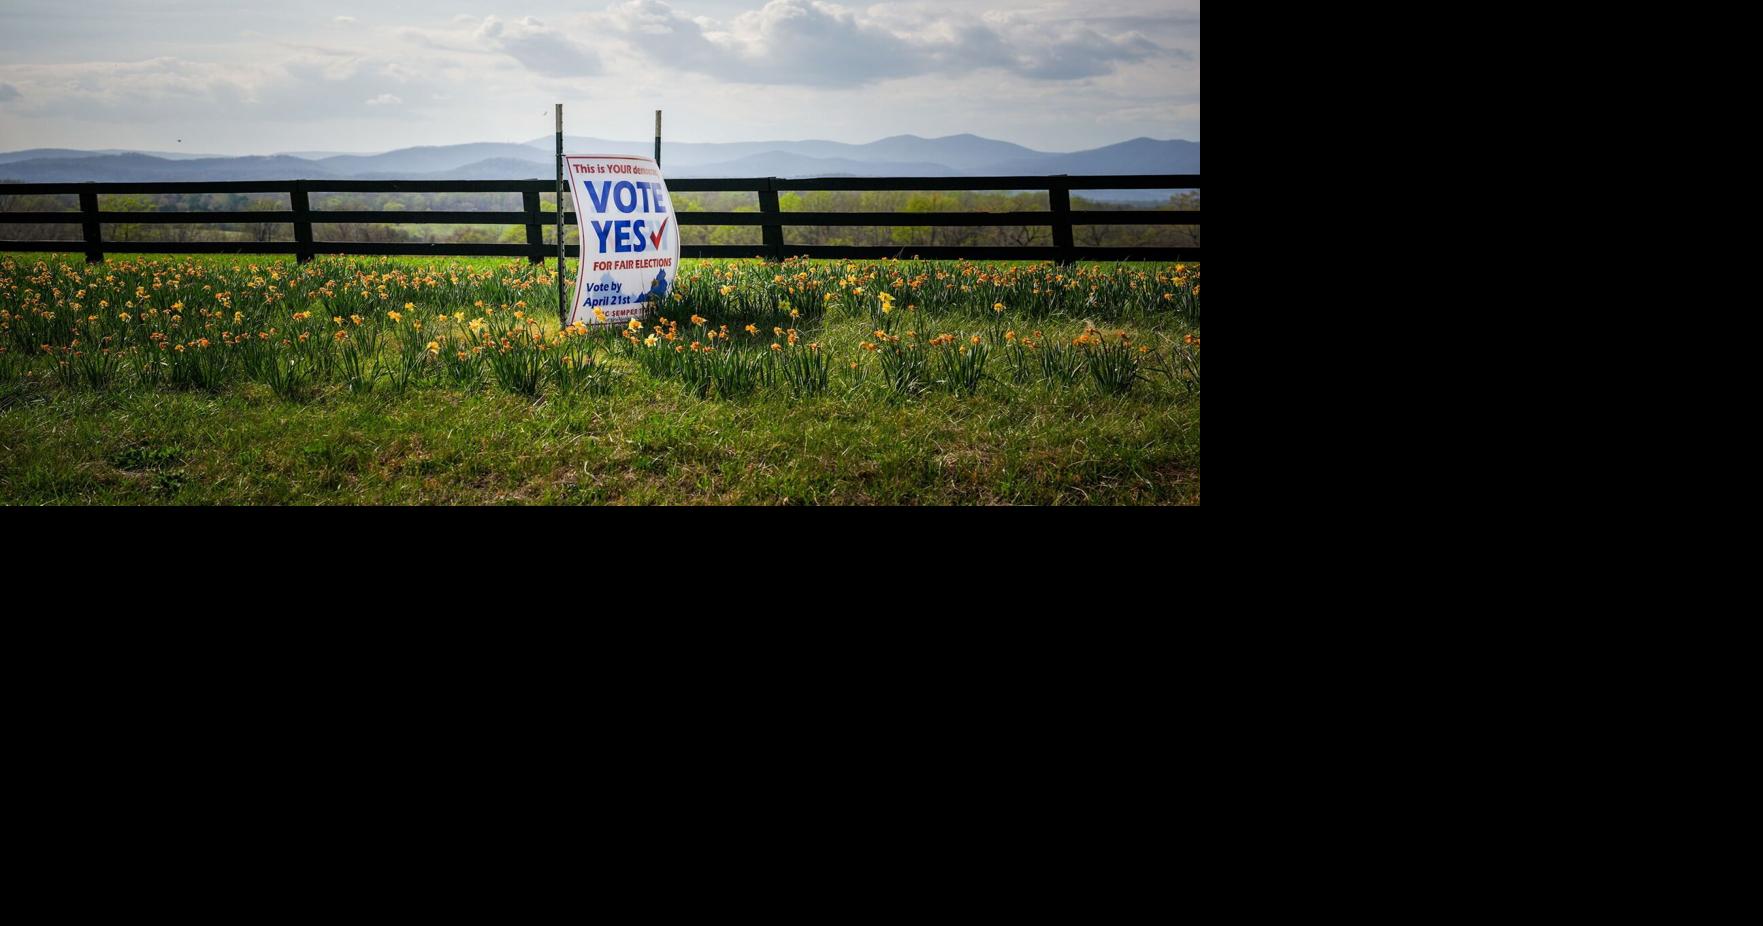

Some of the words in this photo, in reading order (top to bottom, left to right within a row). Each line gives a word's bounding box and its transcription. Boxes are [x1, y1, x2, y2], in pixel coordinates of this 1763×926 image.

[573, 164, 595, 174] This
[597, 164, 605, 174] is
[607, 164, 632, 175] YOUR
[583, 180, 667, 214] VOTE
[591, 219, 647, 254] YES
[593, 261, 613, 271] FOR
[614, 260, 634, 270] FAIR
[635, 257, 672, 269] ELECTIONS
[586, 282, 610, 293] Vote
[611, 281, 622, 293] by
[583, 296, 610, 309] April
[610, 295, 631, 305] 21st
